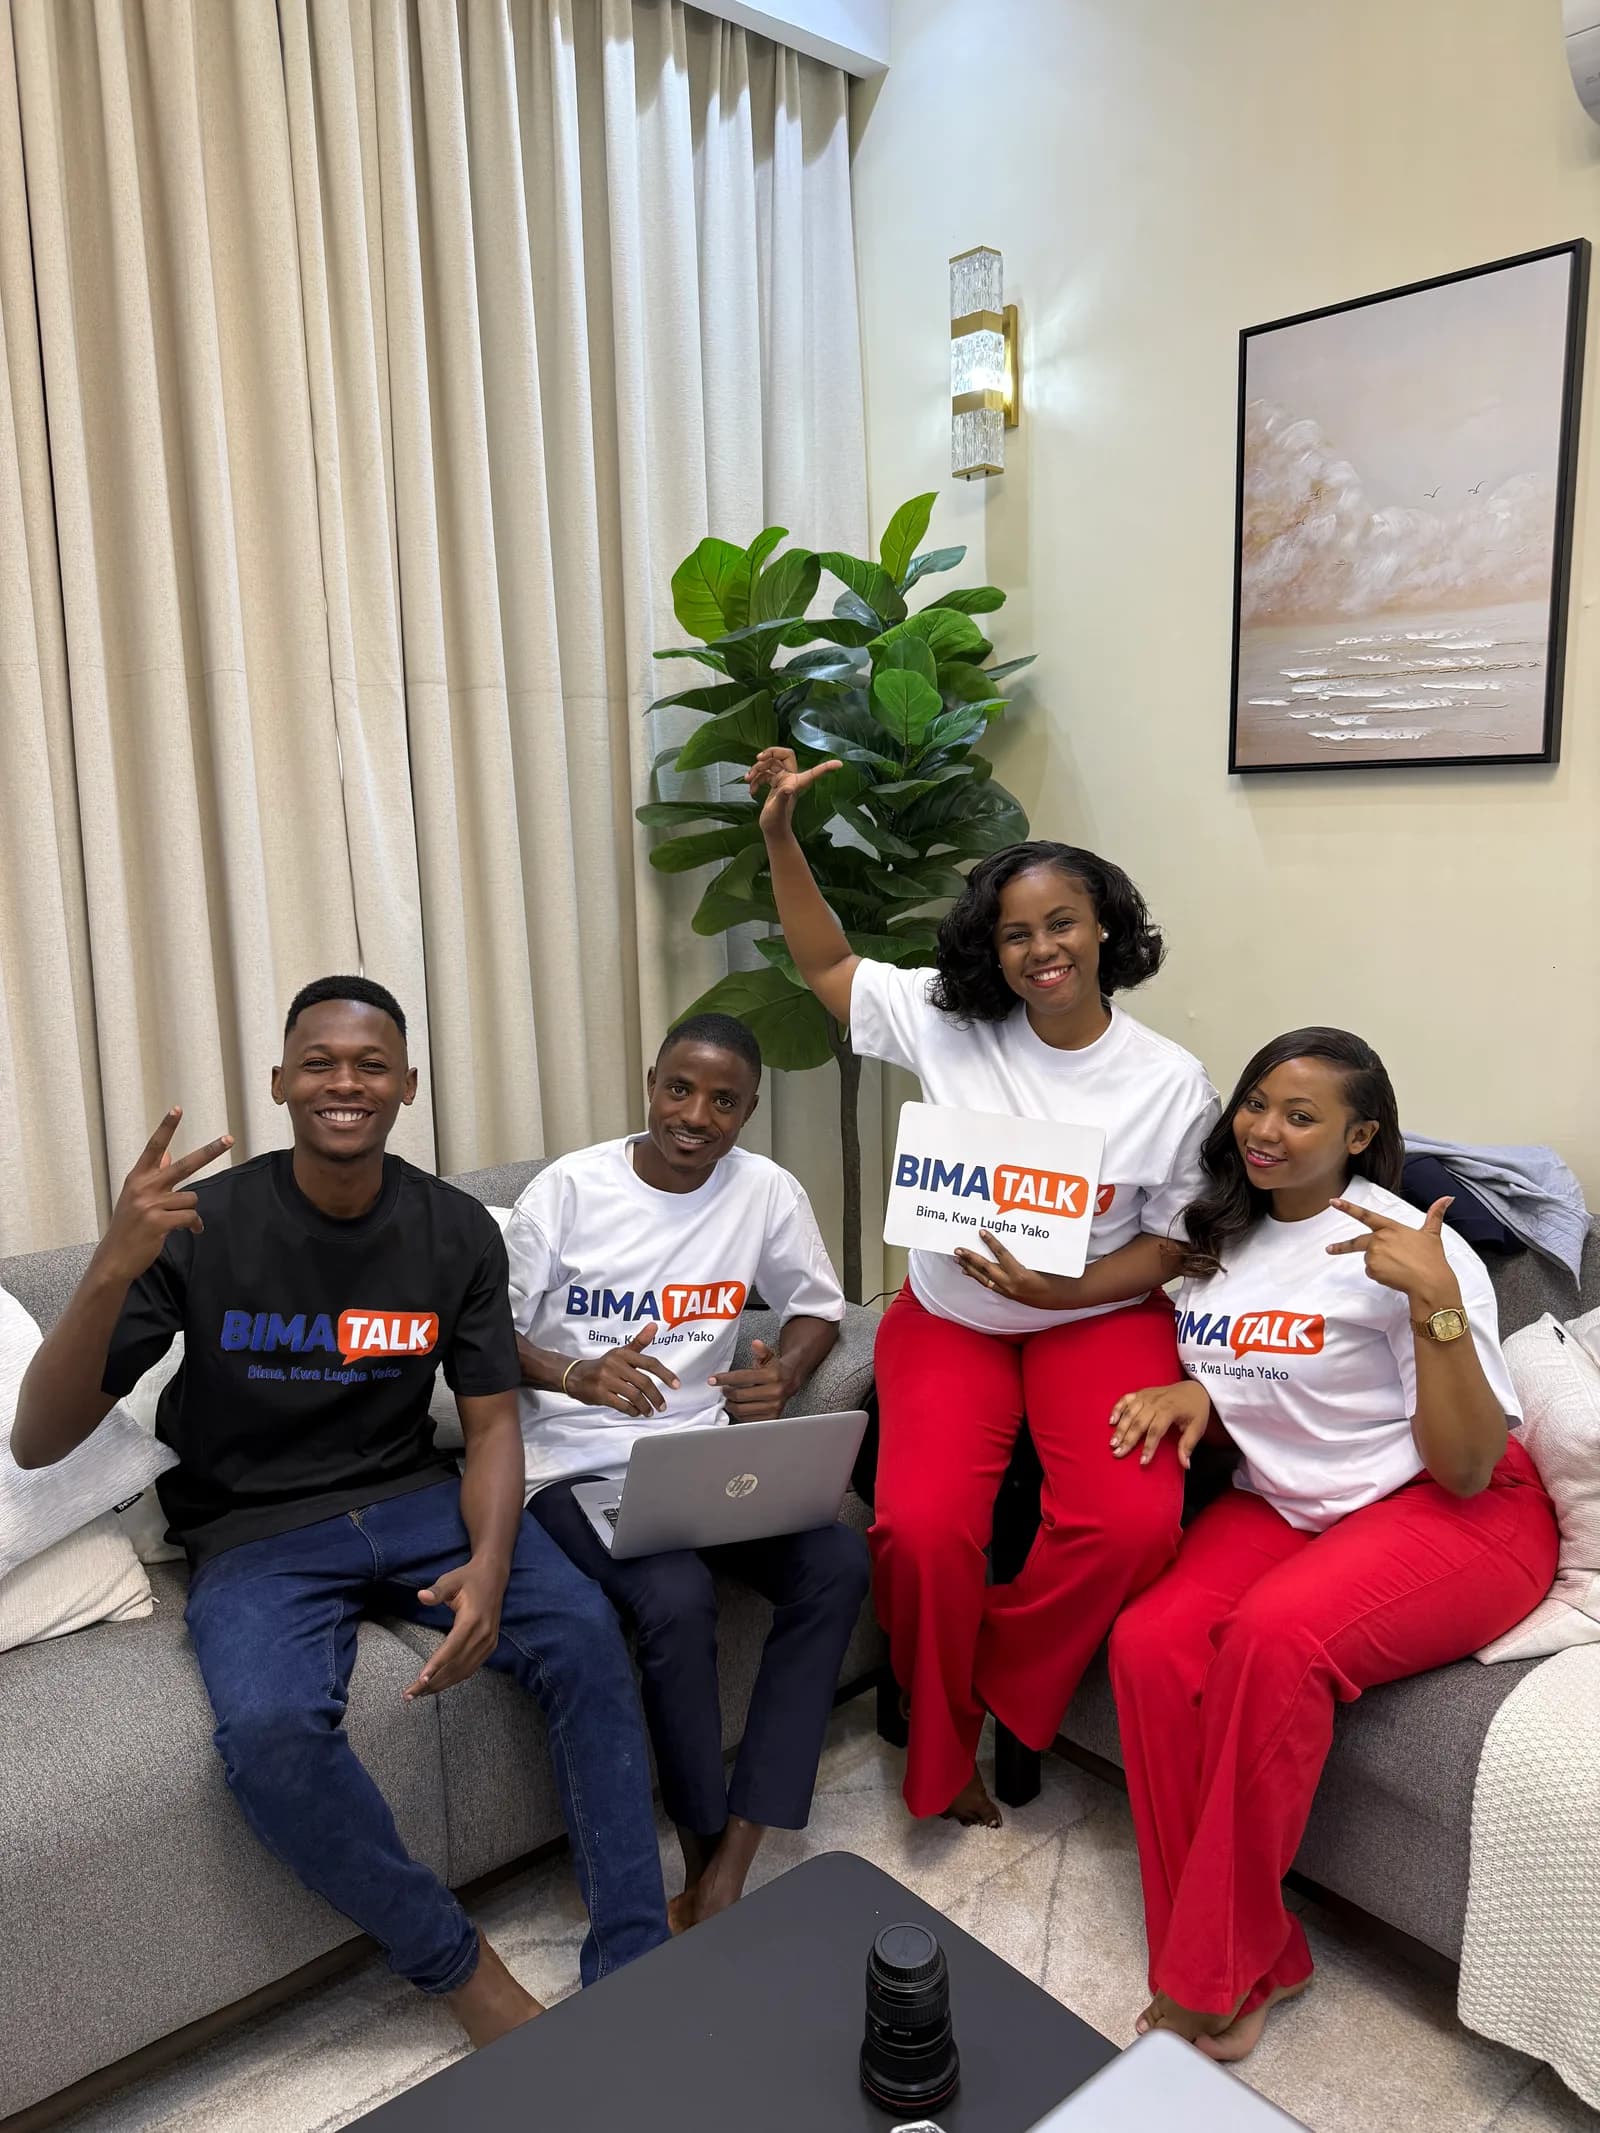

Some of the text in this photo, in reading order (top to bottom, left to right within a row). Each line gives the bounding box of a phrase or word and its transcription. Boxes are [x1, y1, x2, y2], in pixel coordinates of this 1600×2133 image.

[896, 1153, 991, 1202] BIMA
[1000, 1170, 1080, 1213] TALK
[915, 1205, 1050, 1239] Bima, Kwa Lugha Yako
[565, 1284, 739, 1322] BIMA TALK
[220, 1309, 433, 1353] BIMA TALK
[588, 1329, 620, 1345] Bima,
[652, 1332, 684, 1346] Lugha
[687, 1331, 715, 1343] Yako
[1237, 1315, 1316, 1349] TALK
[247, 1365, 401, 1385] Bima, Kwa Lugha Yako
[1200, 1361, 1221, 1375] Kwa
[1223, 1363, 1255, 1380] Lugha
[1256, 1366, 1289, 1381] Yako
[728, 1474, 757, 1498] hp
